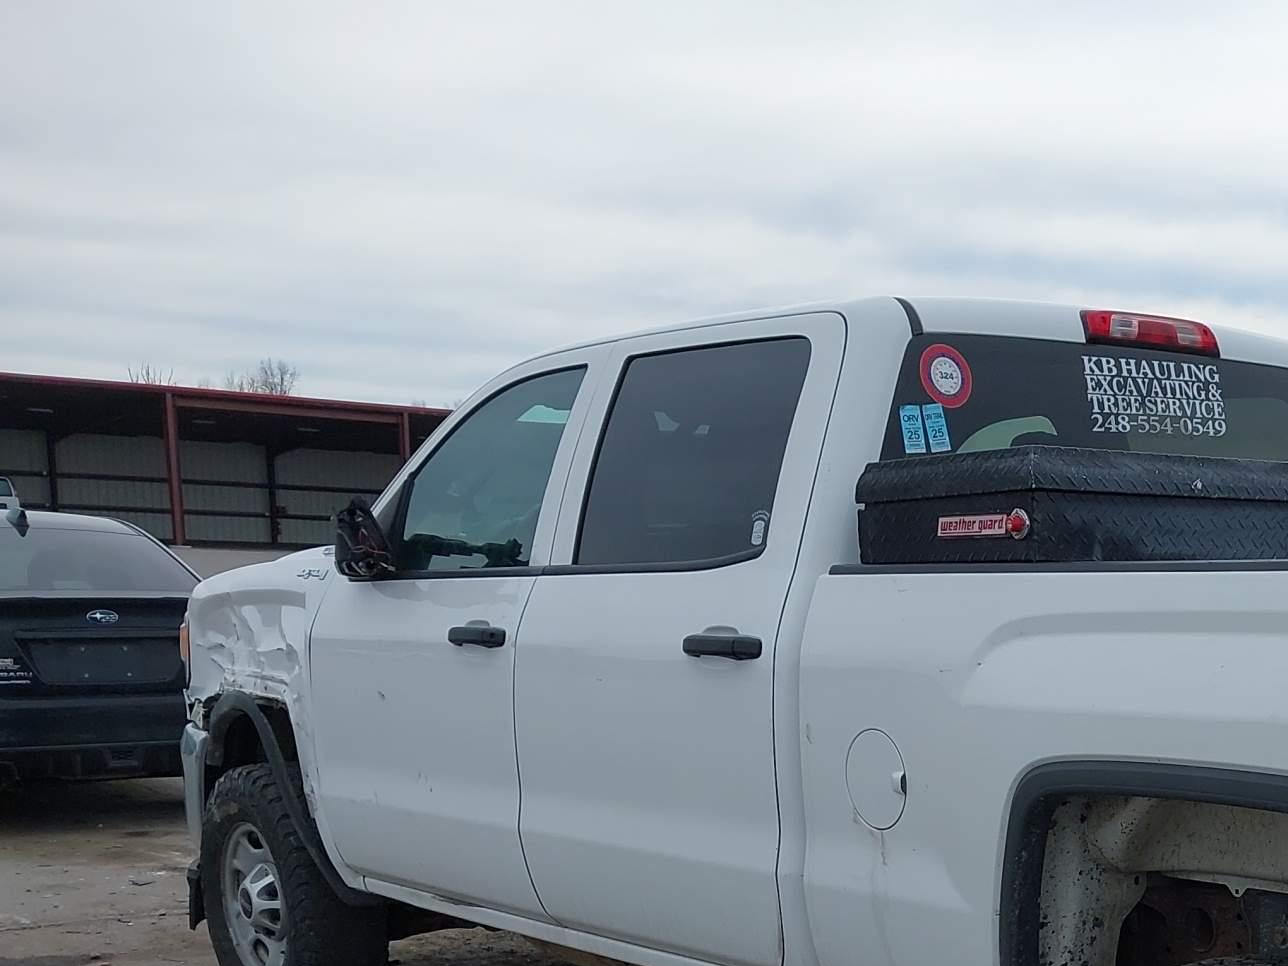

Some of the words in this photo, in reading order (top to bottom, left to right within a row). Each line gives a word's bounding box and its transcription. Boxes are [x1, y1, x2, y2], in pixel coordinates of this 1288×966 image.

[1081, 355, 1118, 376] KB
[1118, 358, 1220, 383] HAULING
[1084, 375, 1206, 400] EXCAVATING
[1208, 384, 1223, 401] &
[1087, 393, 1144, 414] TREE
[1145, 398, 1226, 419] SERVICE
[907, 430, 921, 440] 25
[931, 427, 945, 438] 25
[1091, 414, 1226, 437] 248-554-0549
[940, 518, 976, 531] weather
